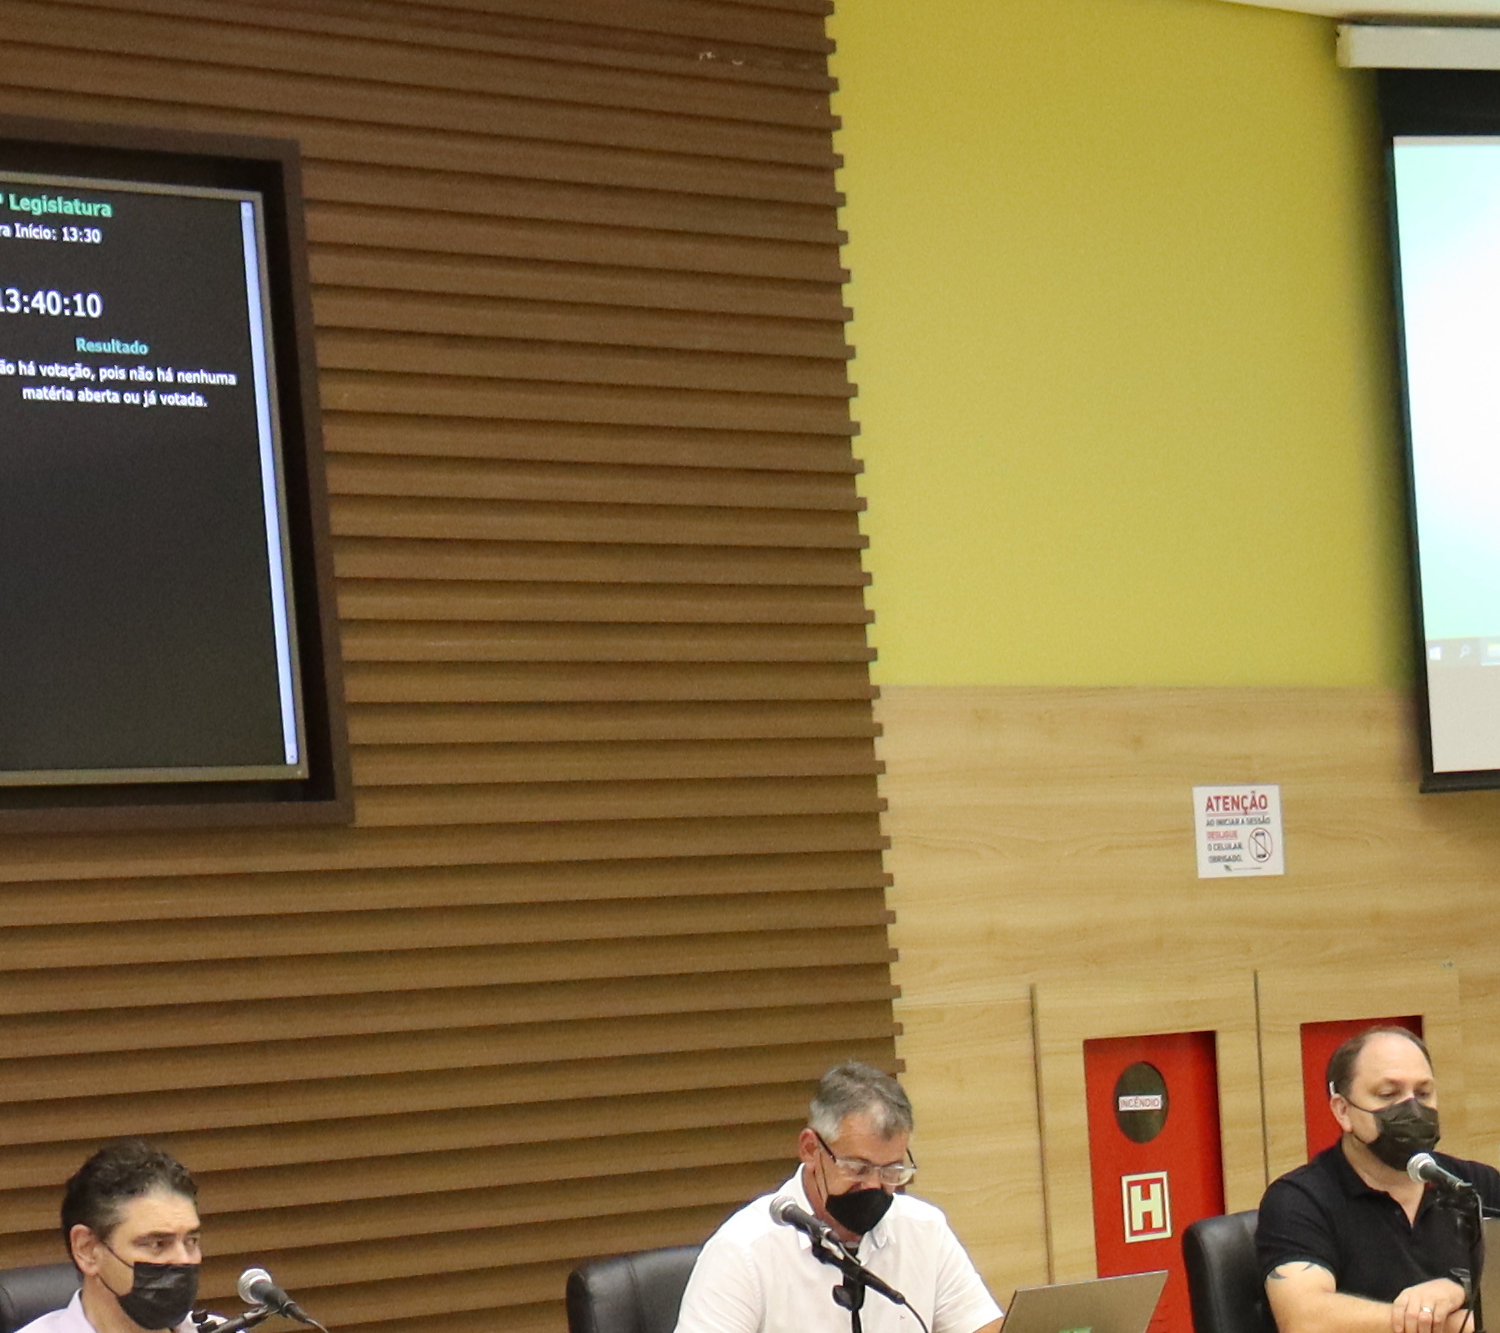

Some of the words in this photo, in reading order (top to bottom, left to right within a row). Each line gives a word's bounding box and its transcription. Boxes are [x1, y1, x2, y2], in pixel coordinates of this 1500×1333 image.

[9, 194, 113, 218] Legislatura
[15, 223, 57, 241] Início:
[62, 227, 102, 244] 13:30
[76, 337, 149, 355] Resultado
[18, 360, 35, 376] há
[39, 362, 96, 382] votação,
[99, 365, 126, 383] pois
[129, 366, 153, 381] não
[156, 367, 173, 382] há
[177, 371, 237, 386] nenhuma
[22, 386, 74, 401] matéria
[77, 388, 120, 403] aberta
[123, 391, 140, 404] ou
[142, 390, 156, 408] já
[160, 392, 208, 407] votada.
[1206, 790, 1267, 814] ATENÇÃO
[1130, 1183, 1164, 1231] H
